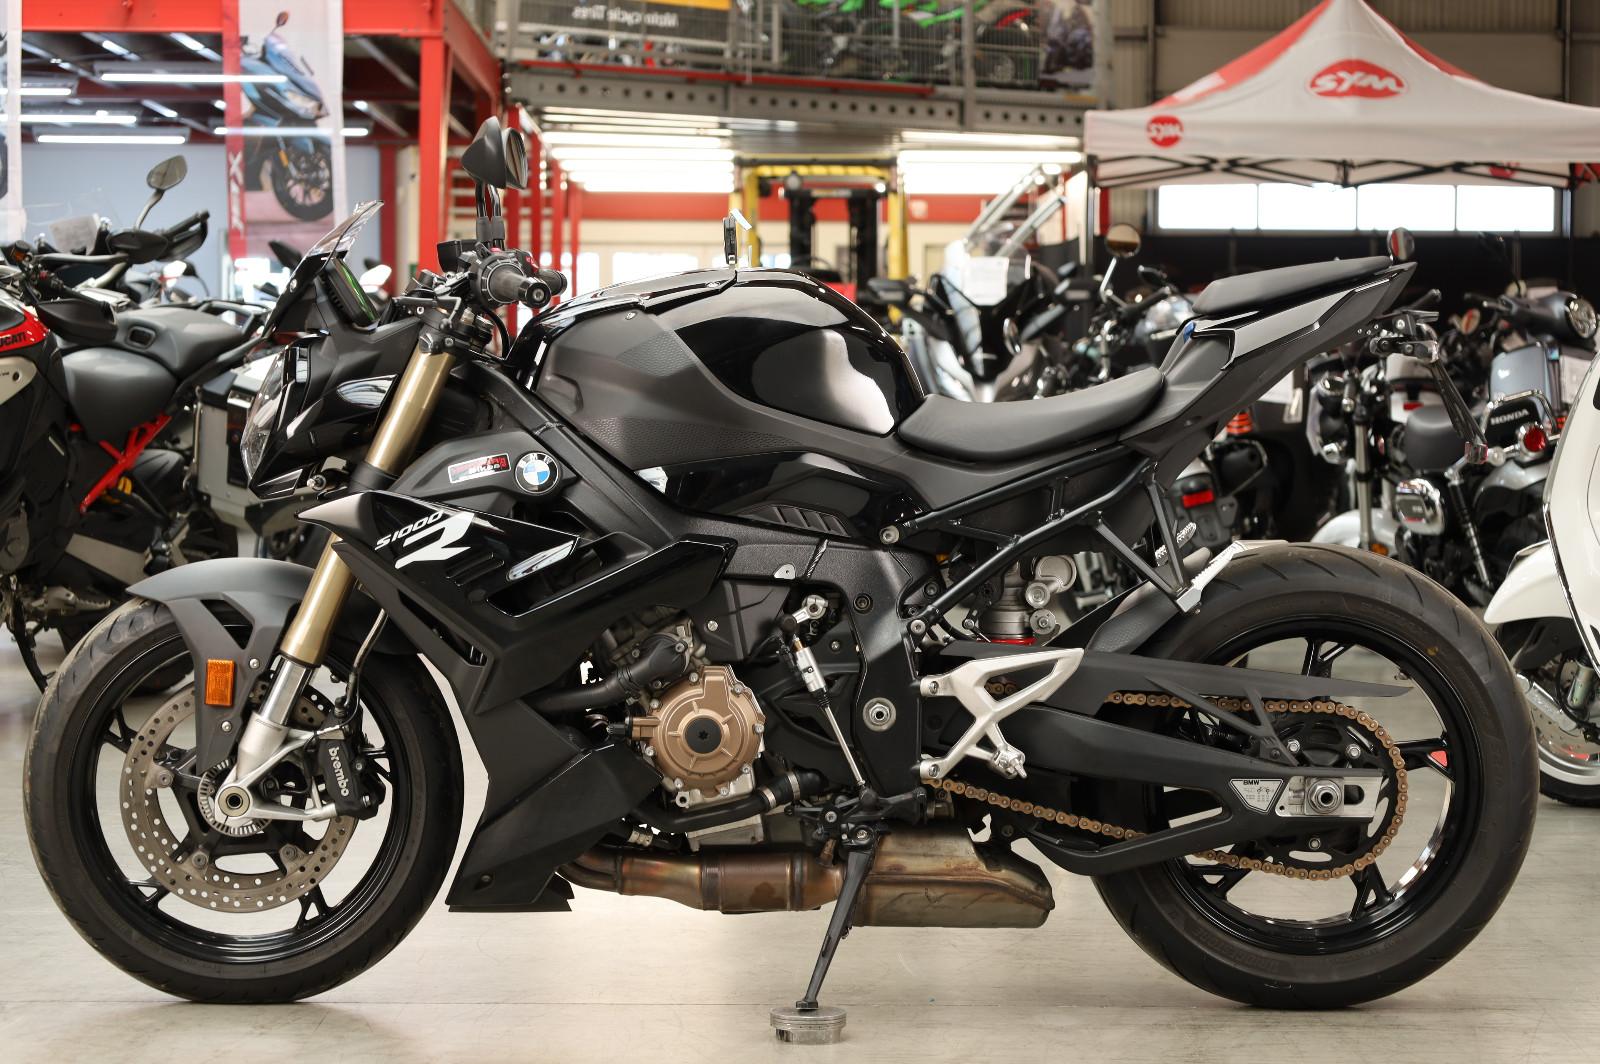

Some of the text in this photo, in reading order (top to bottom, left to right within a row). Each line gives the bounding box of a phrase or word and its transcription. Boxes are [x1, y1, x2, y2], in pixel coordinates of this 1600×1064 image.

[1314, 70, 1404, 93] SYM
[1150, 122, 1183, 141] SYM
[1490, 408, 1530, 426] HONDA
[374, 510, 445, 551] S1000
[328, 746, 349, 797] brembo
